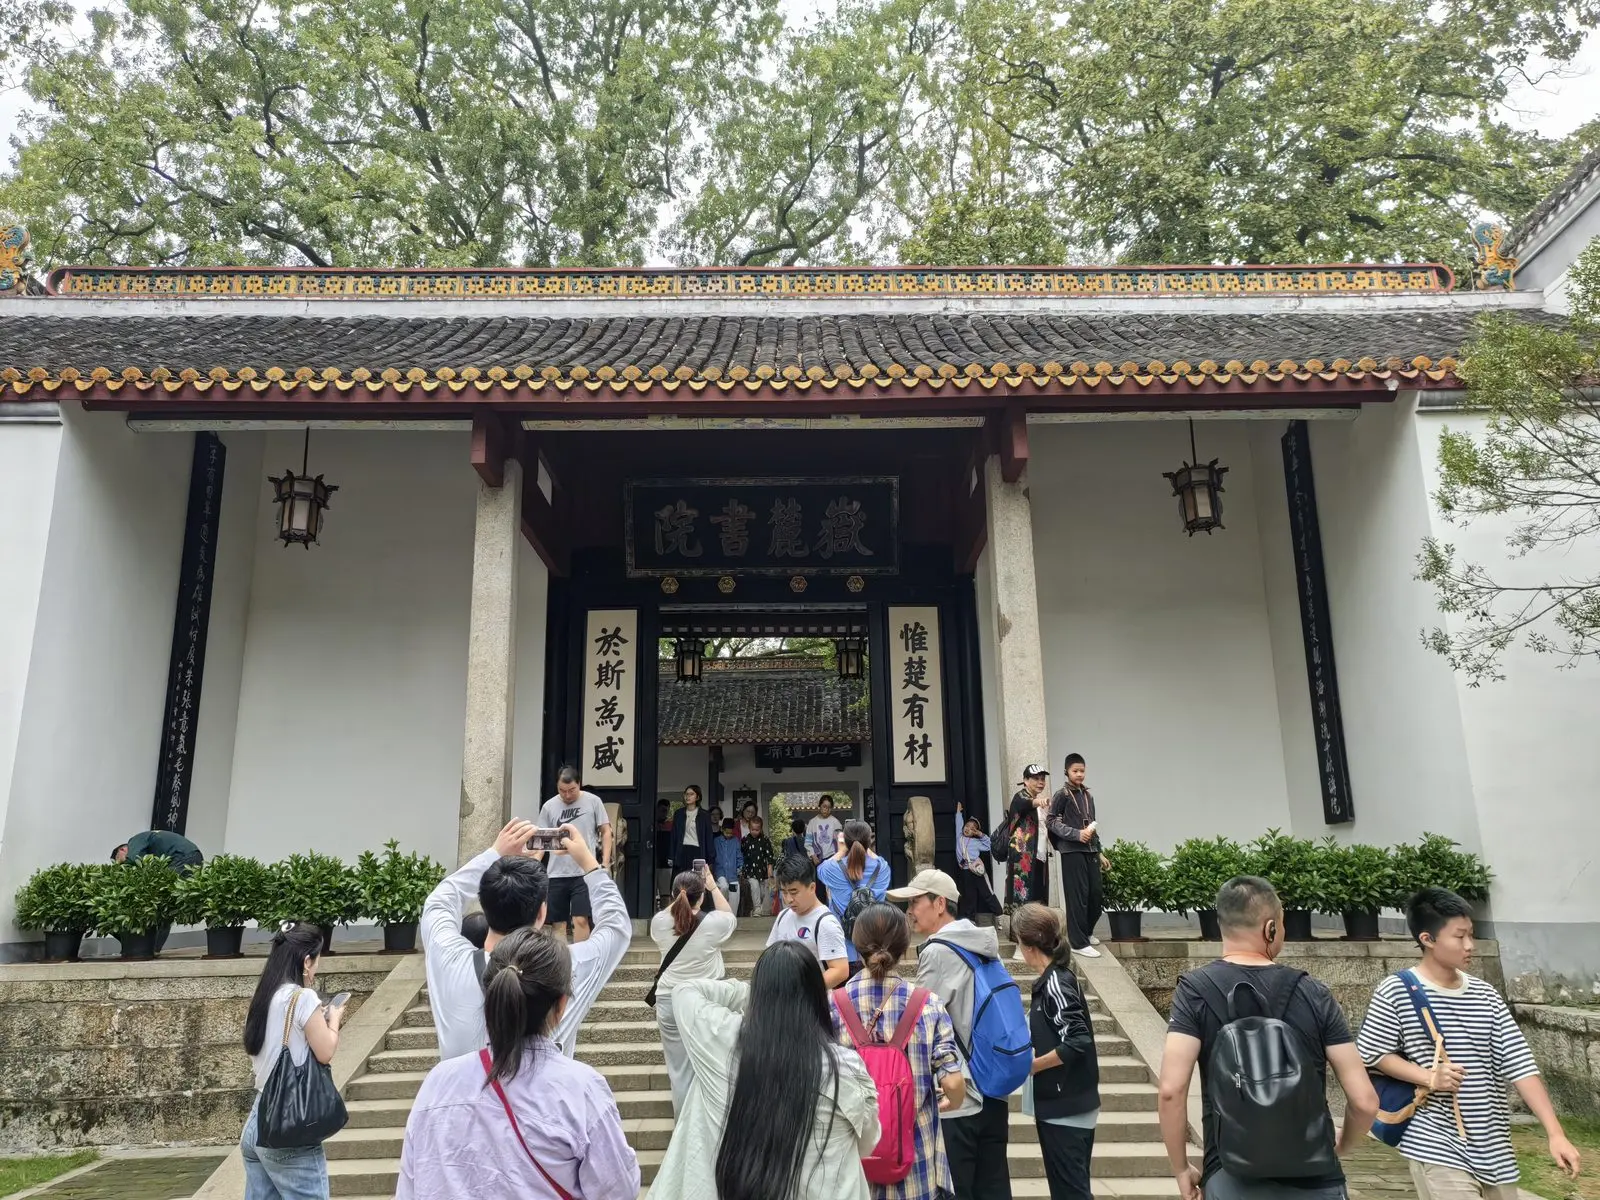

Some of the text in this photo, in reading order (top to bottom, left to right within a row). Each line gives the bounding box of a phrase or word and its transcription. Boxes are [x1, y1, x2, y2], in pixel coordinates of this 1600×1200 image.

[900, 622, 932, 768] 惟楚有材
[561, 808, 580, 819] NIKE
